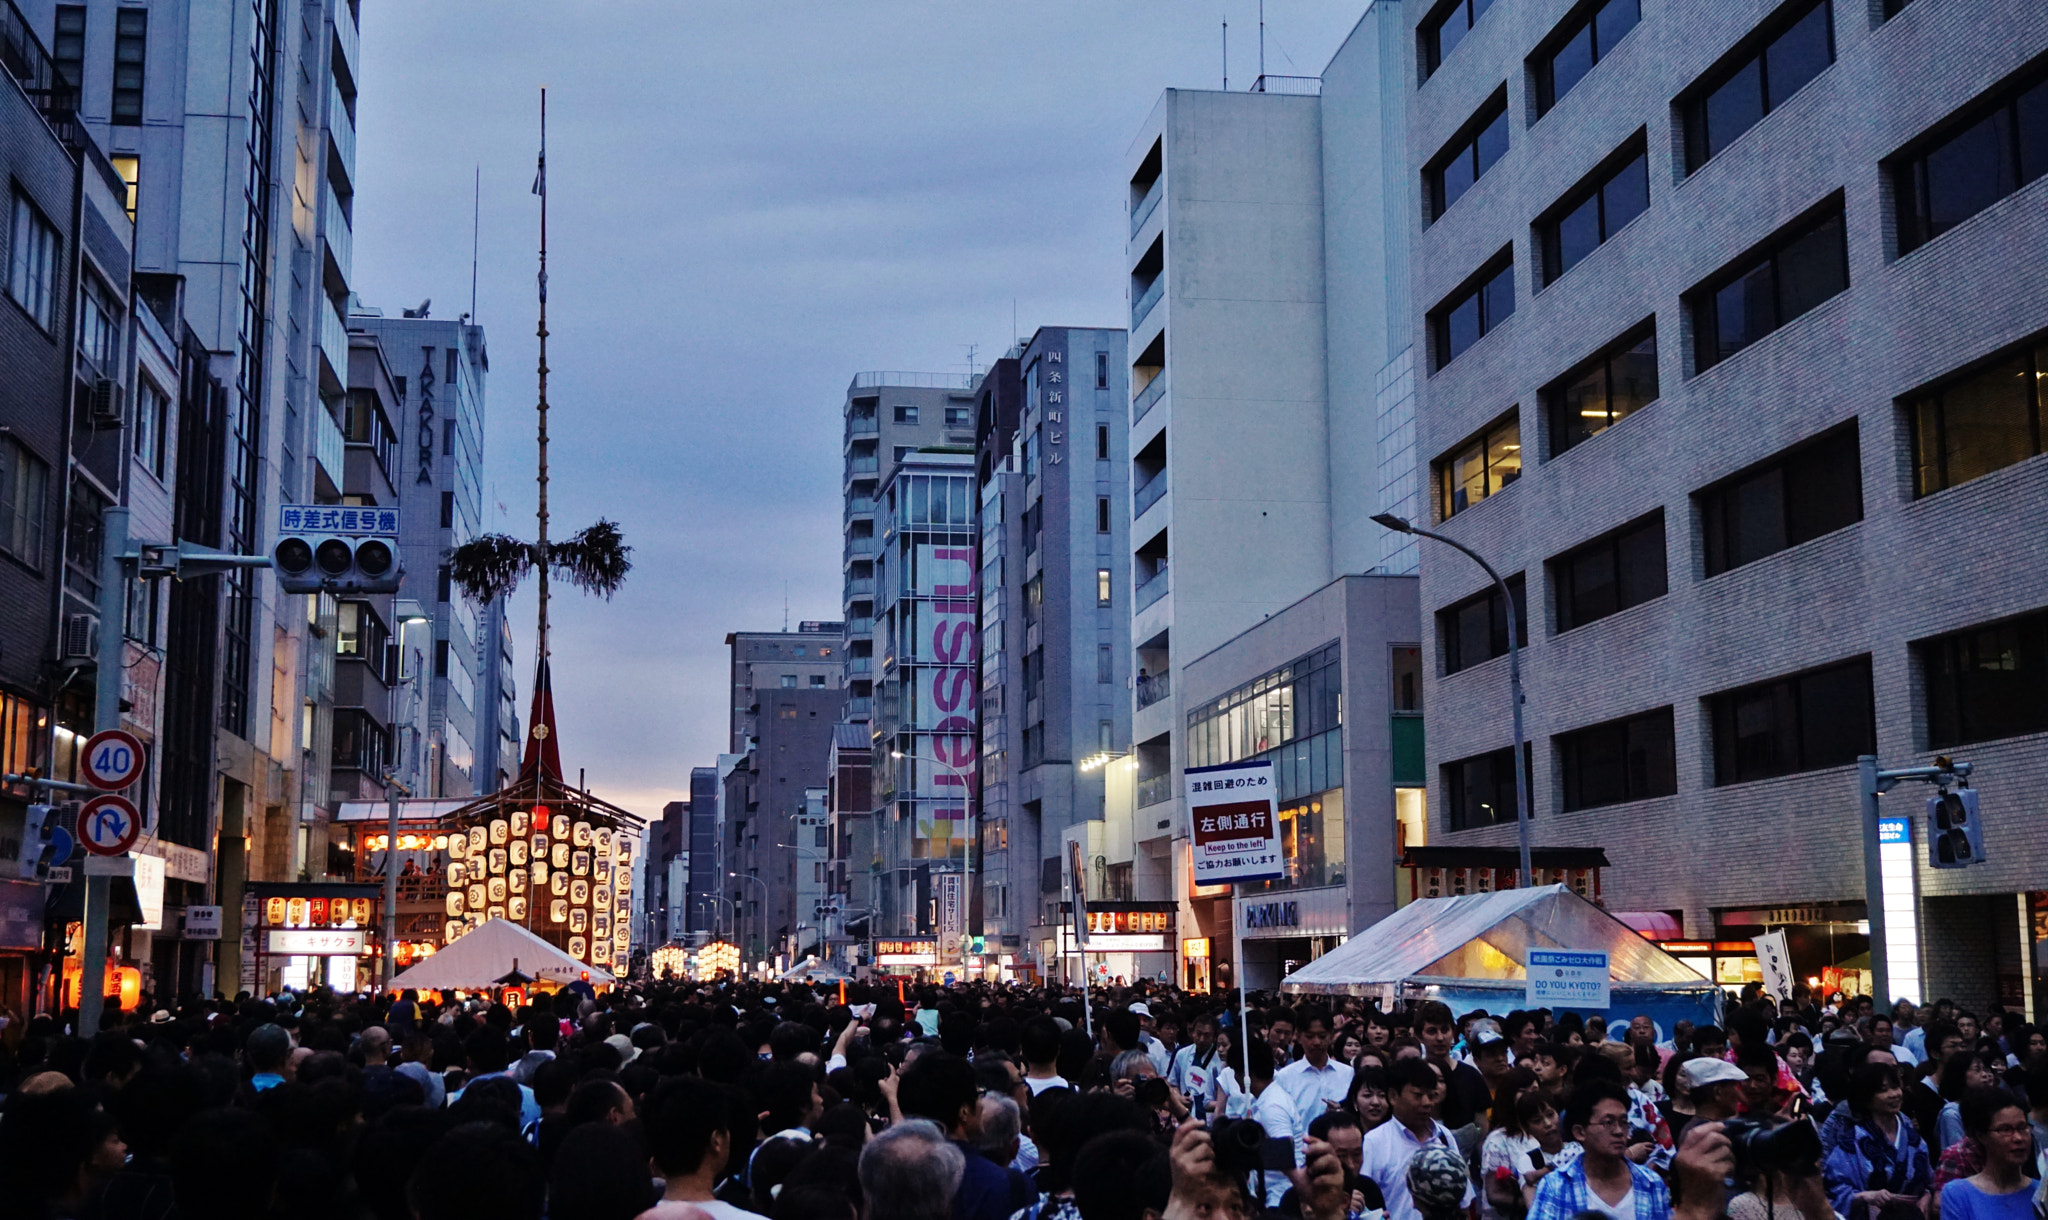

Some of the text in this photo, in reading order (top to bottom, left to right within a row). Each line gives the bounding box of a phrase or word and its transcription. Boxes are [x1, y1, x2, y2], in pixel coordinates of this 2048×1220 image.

[416, 346, 435, 485] TAKAKURA
[1048, 351, 1062, 466] 四条新町ビル
[284, 509, 397, 532] 時差式信号機
[95, 748, 130, 774] 40
[1191, 775, 1268, 793] 混雑回避のため
[1200, 812, 1266, 833] 左側通行
[1207, 838, 1263, 854] Keep to the left
[1197, 853, 1277, 870] ご協力お願いします
[307, 937, 356, 949] キザクラ
[1535, 980, 1602, 990] DO YOU KYOTO?
